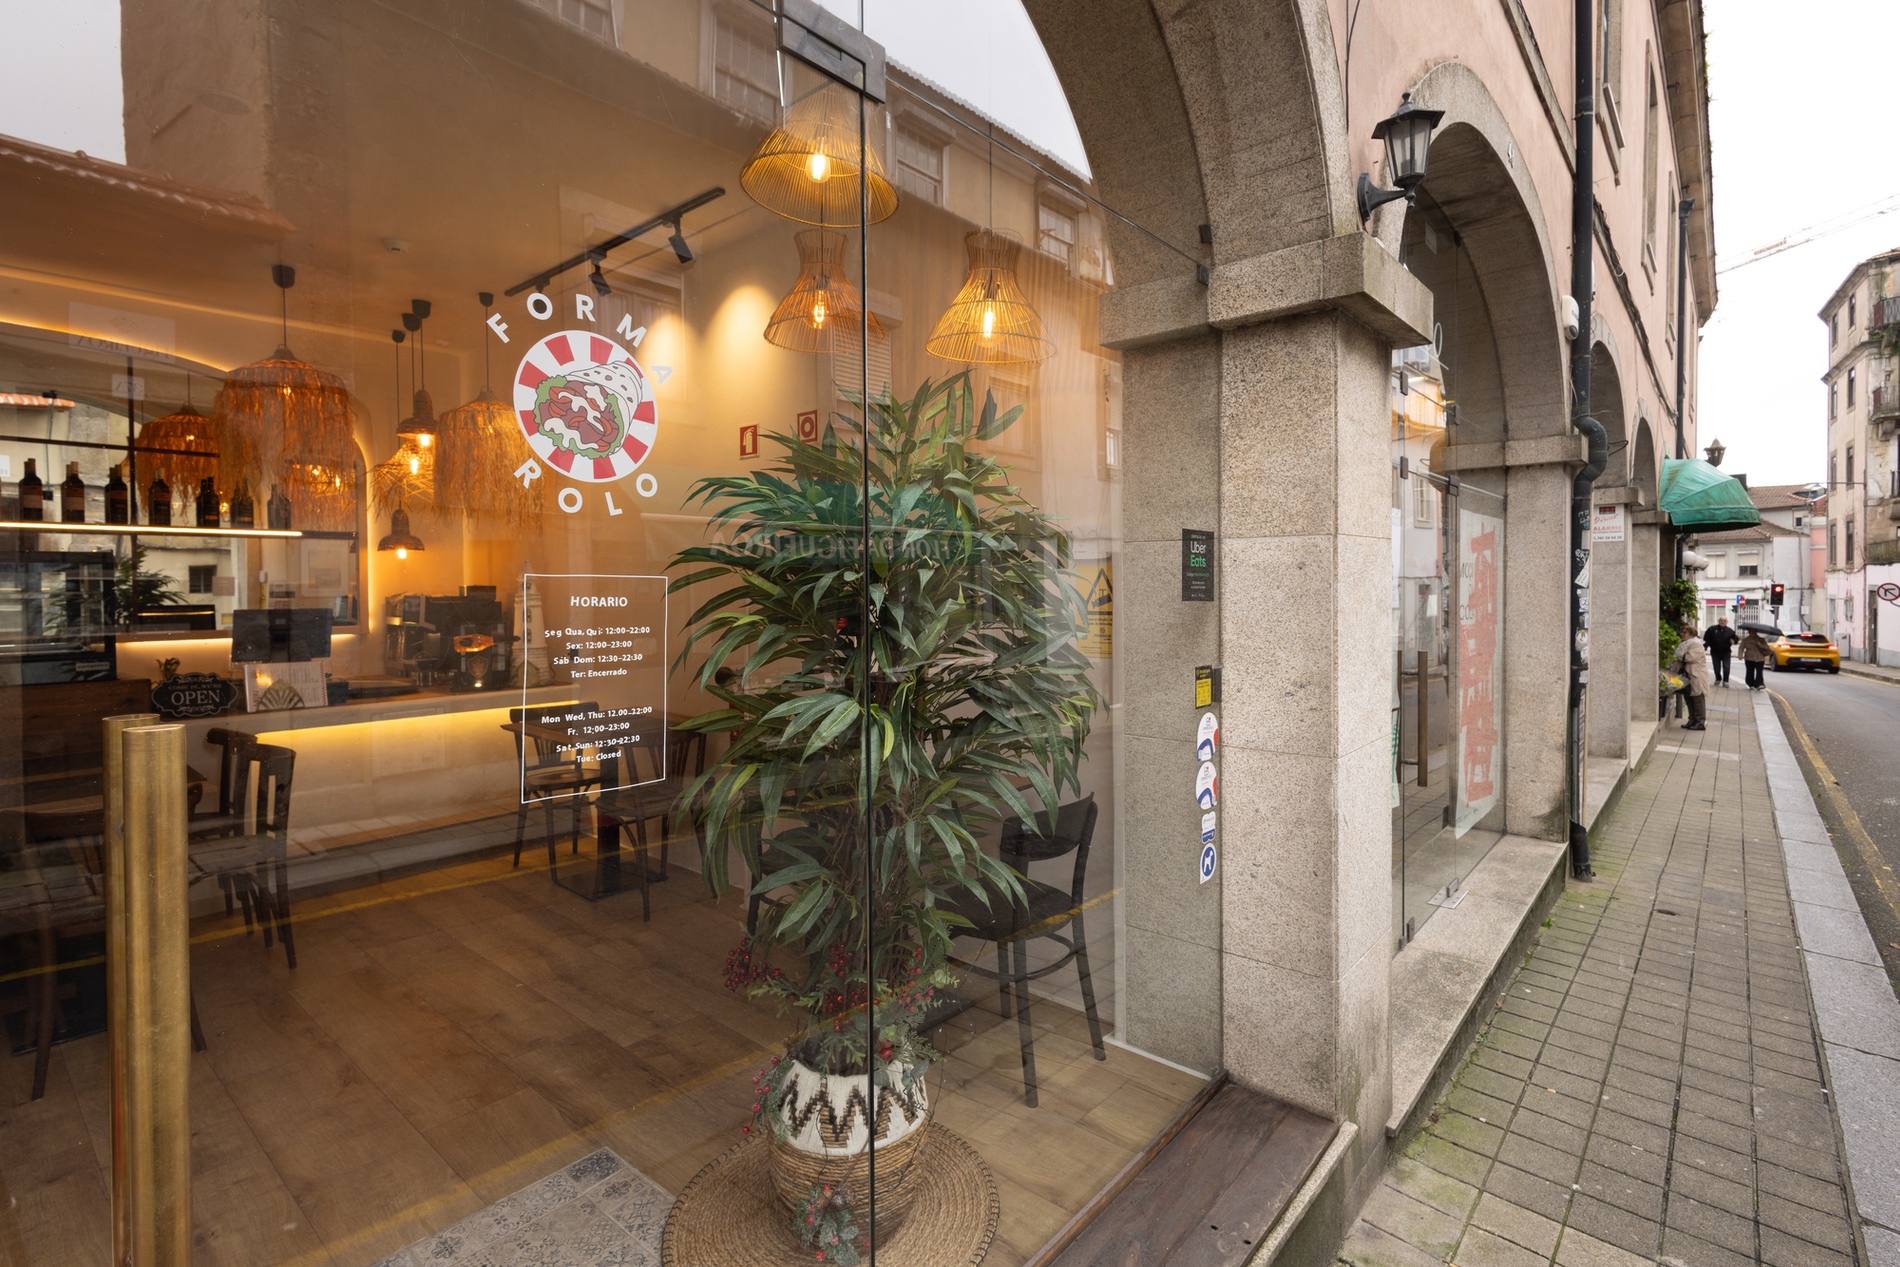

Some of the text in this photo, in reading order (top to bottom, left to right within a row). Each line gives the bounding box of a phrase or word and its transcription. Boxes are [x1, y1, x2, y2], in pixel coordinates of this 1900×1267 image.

[486, 292, 673, 386] FORMA
[513, 458, 658, 517] ROLO
[1190, 541, 1206, 554] Uber
[1190, 554, 1206, 567] Eats
[570, 596, 628, 607] HORARIO
[544, 629, 562, 638] Seg
[566, 642, 584, 650] Sex:
[573, 656, 596, 664] Dom:
[570, 667, 627, 678] Ter: Encerrado
[171, 690, 220, 705] OPEN
[541, 715, 561, 724] Mon
[565, 712, 586, 722] Wed,
[587, 711, 606, 719] Thu:
[576, 749, 622, 763] Tue: Closed
